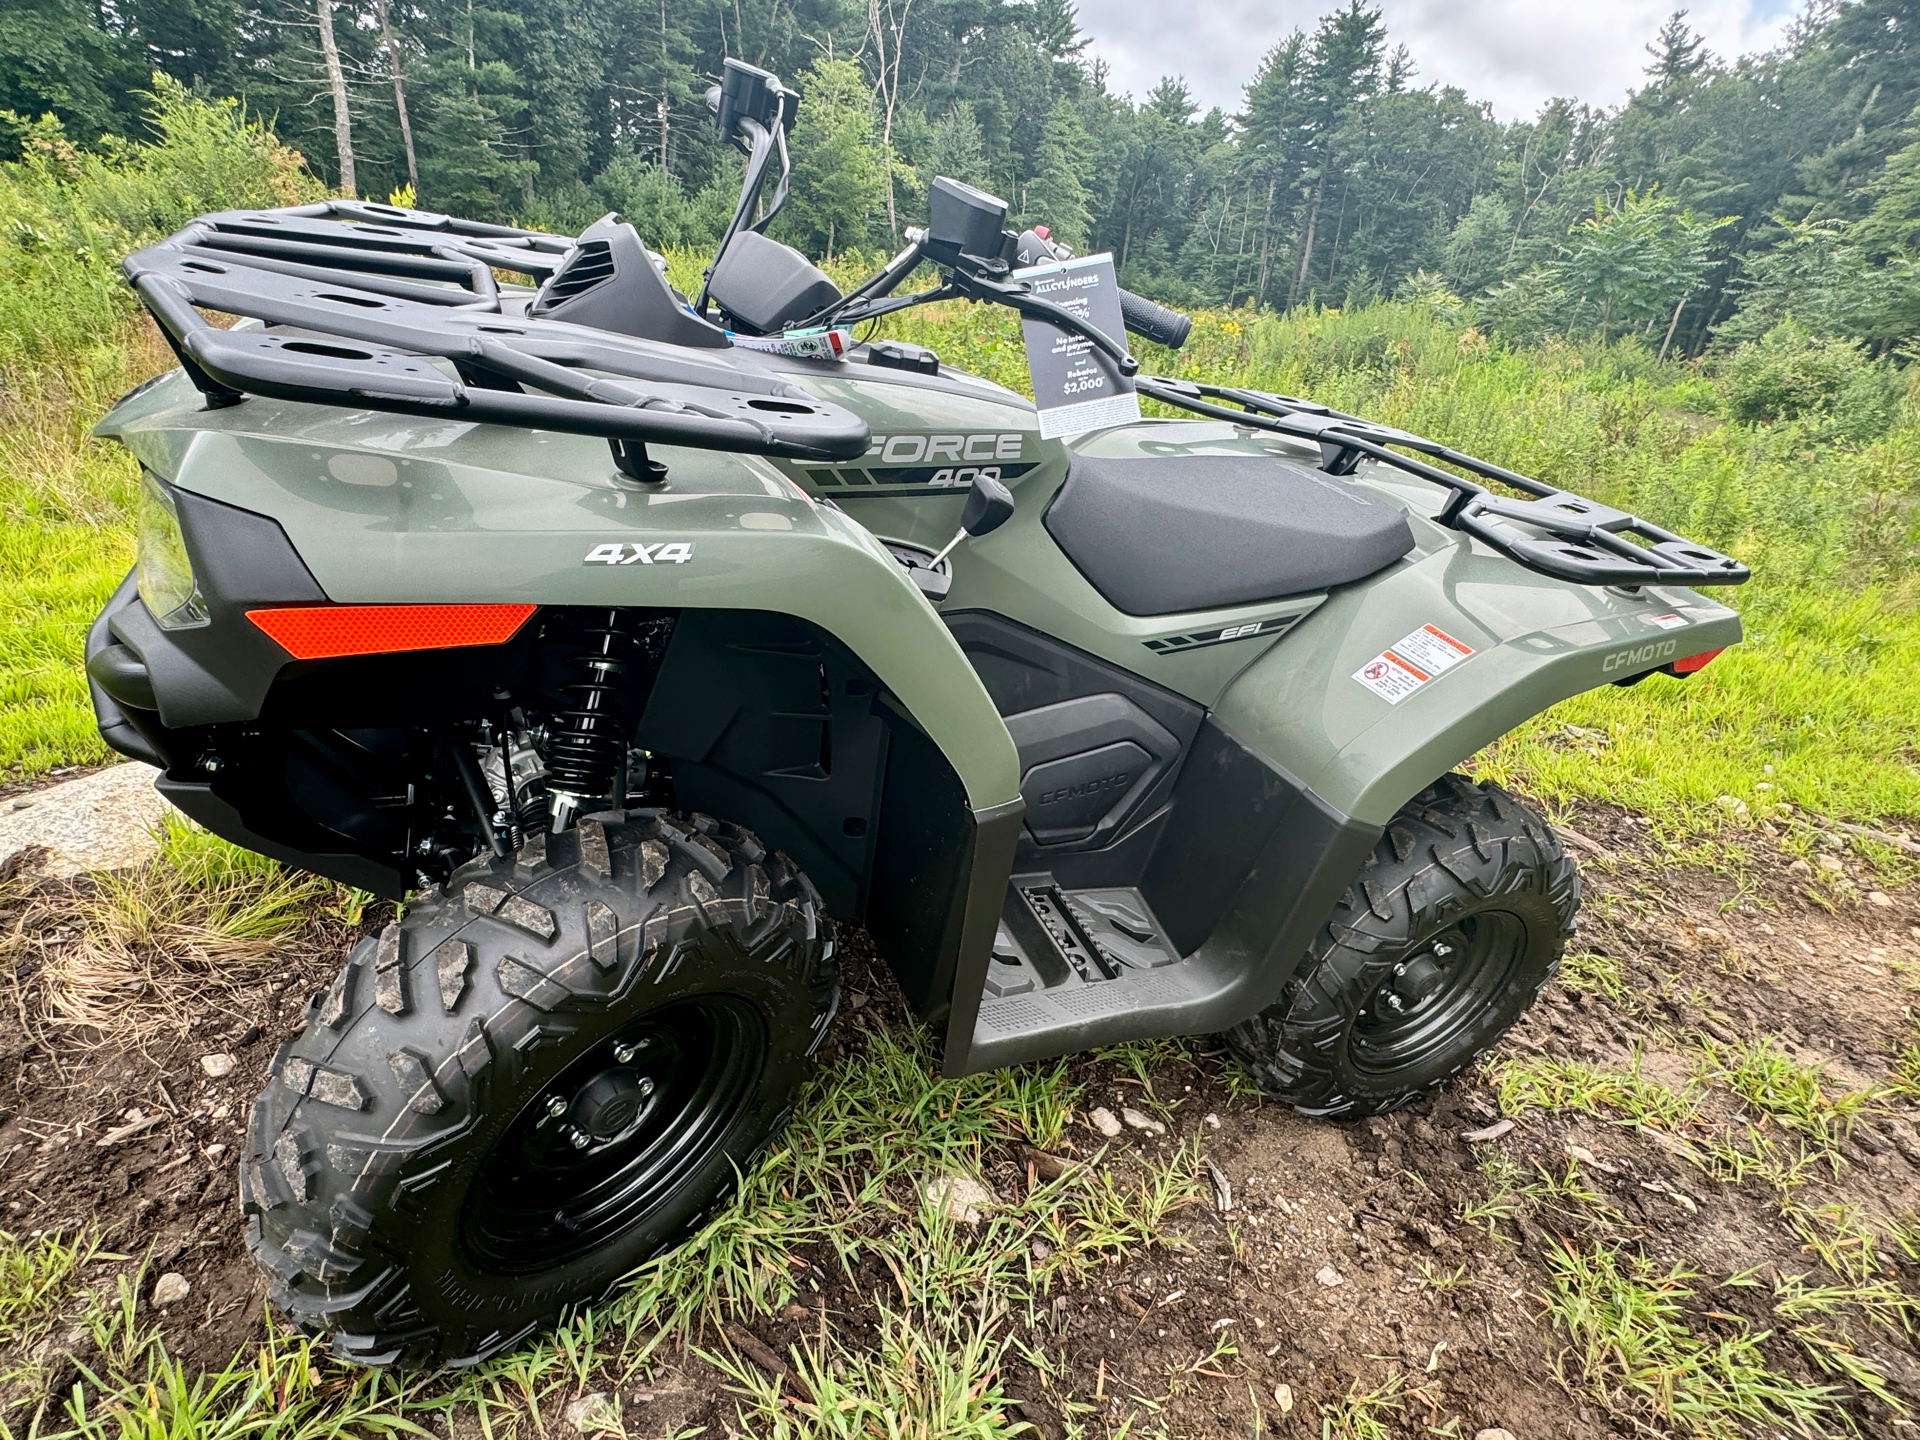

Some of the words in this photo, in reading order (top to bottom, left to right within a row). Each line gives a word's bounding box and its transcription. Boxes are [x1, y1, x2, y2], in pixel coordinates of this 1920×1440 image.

[1055, 297, 1088, 307] nancing
[1051, 345, 1066, 353] and
[1067, 341, 1095, 352] payme
[1056, 337, 1068, 345] No
[1067, 367, 1097, 379] Rebates
[928, 466, 1001, 488] 400
[1219, 622, 1262, 640] EFI
[1602, 639, 1677, 672] CFMOTO
[1039, 773, 1129, 806] CFMOTO
